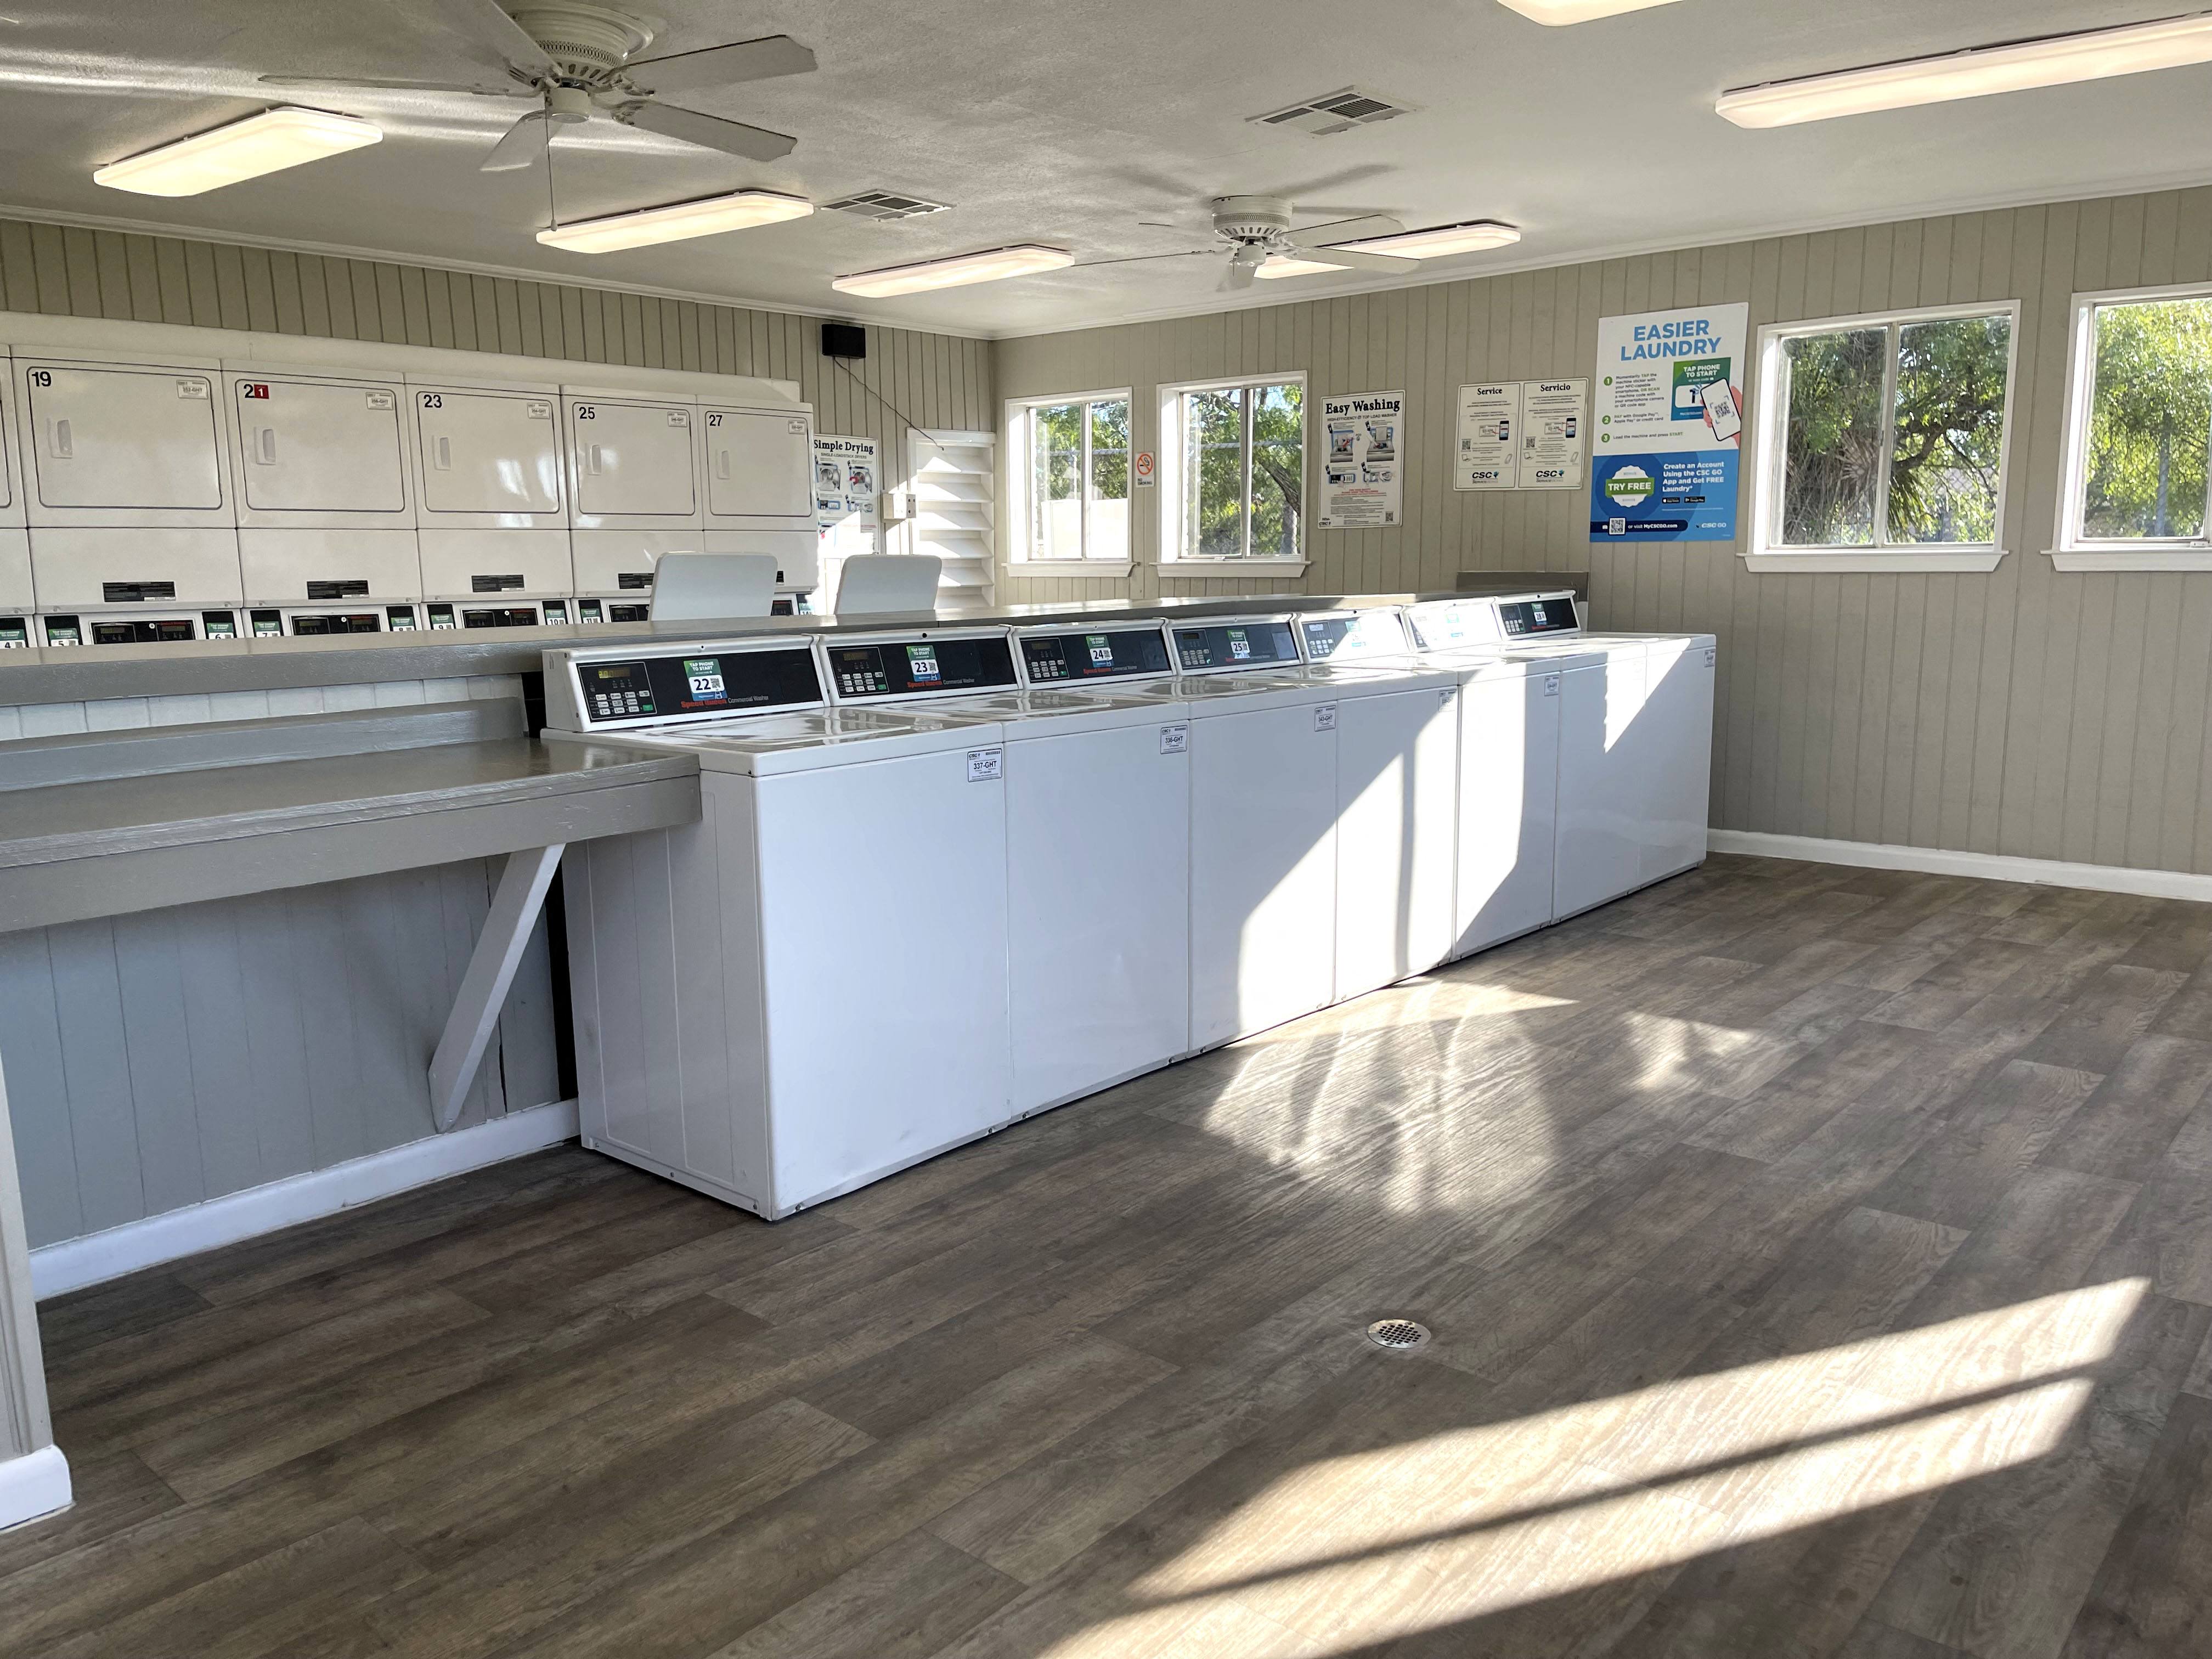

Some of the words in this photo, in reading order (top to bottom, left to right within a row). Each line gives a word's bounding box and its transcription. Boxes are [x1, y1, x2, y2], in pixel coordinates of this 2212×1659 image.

[1634, 319, 1710, 342] EASIER
[1621, 337, 1722, 361] LAUNDRY
[31, 371, 52, 386] 19
[1477, 387, 1503, 395] Service
[1540, 383, 1571, 392] Servicio
[424, 394, 442, 408] 23
[1689, 389, 1696, 404] 1
[579, 407, 595, 419] 25
[1325, 403, 1350, 416] Easy
[1352, 399, 1400, 412] Washing
[709, 414, 723, 426] 27
[814, 439, 843, 452] Simple
[845, 441, 873, 455] Drying
[1536, 470, 1558, 478] CSC
[1607, 483, 1626, 492] TRY
[1627, 482, 1651, 490] FREE
[1233, 643, 1243, 651] 25
[1093, 650, 1104, 659] 24
[915, 662, 928, 673] 23
[694, 678, 711, 691] 22
[727, 696, 753, 704] Commercial
[974, 761, 997, 770] 337-GHT
